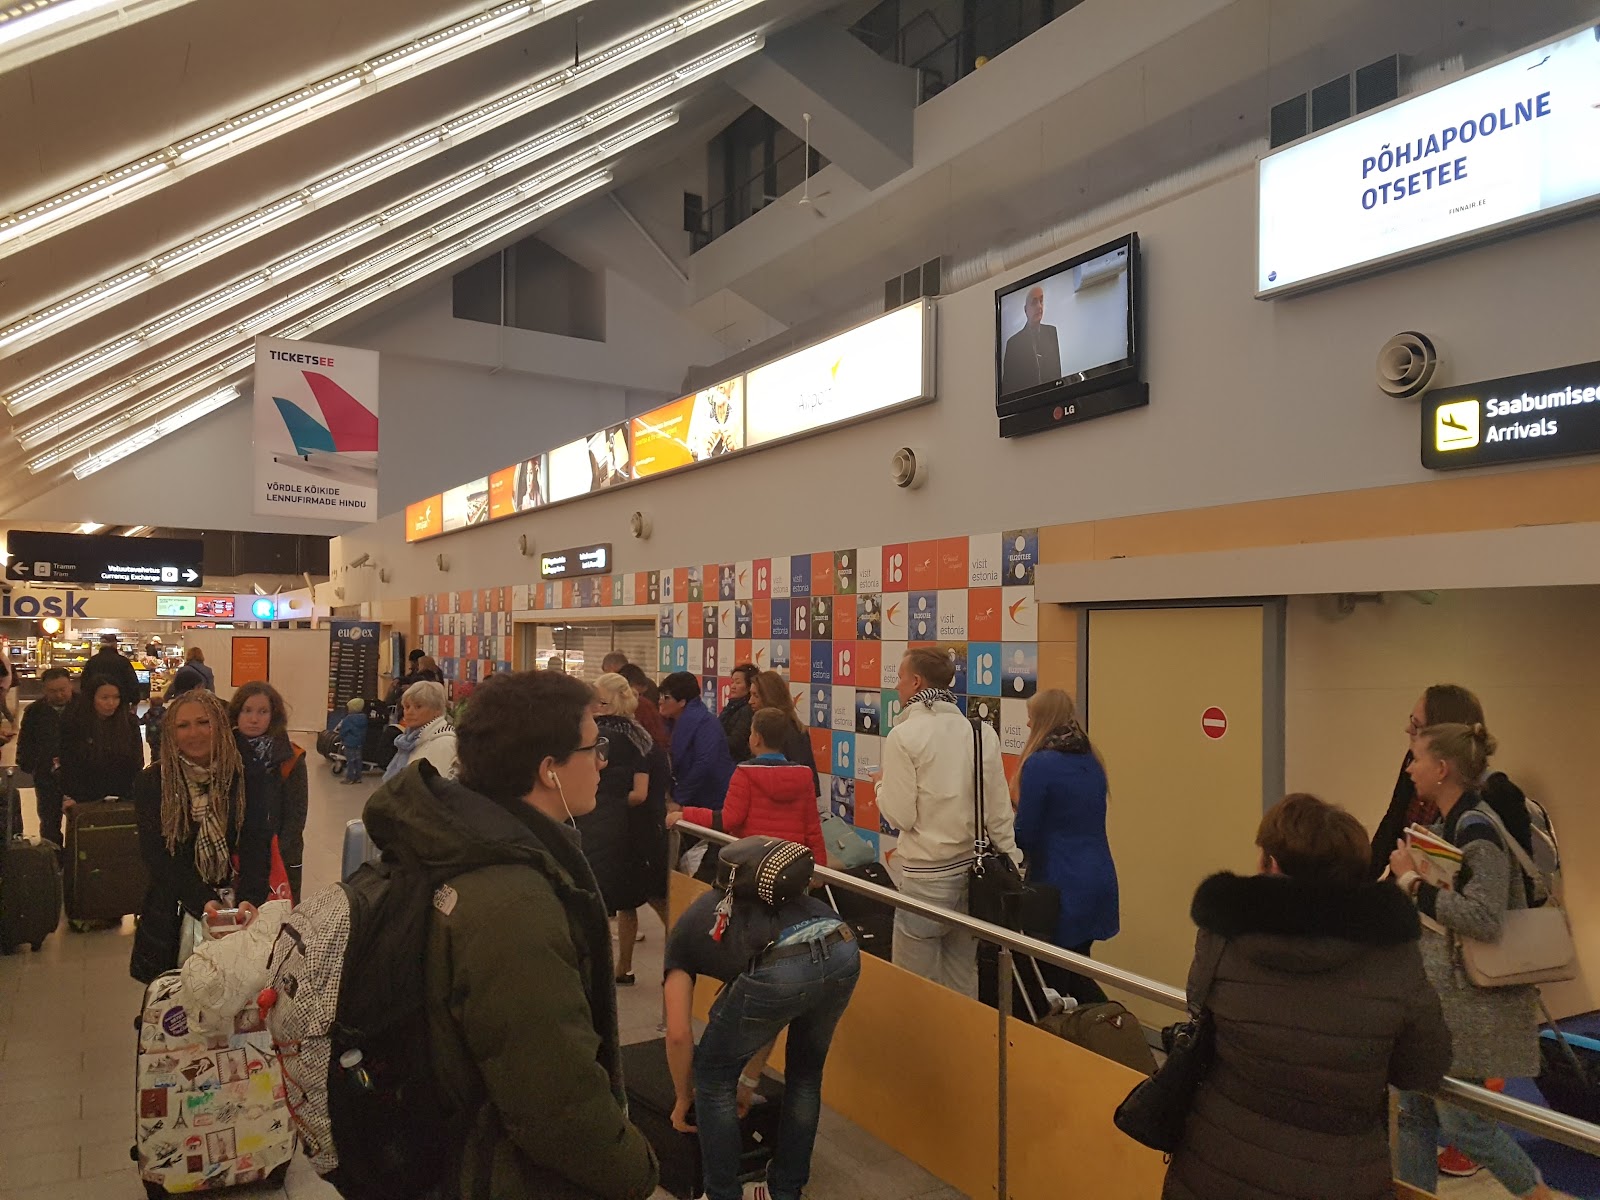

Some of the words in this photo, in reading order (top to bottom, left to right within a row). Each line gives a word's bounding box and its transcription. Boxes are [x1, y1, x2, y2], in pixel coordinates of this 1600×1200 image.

[1362, 91, 1551, 179] PÕHJAPOOLNE
[1361, 156, 1468, 210] OTSETEE
[1449, 199, 1486, 214] FINNAIR.EE
[1064, 405, 1075, 416] LG
[1486, 418, 1557, 443] Arrivals
[267, 482, 302, 493] VÕRDLE
[304, 485, 340, 495] KÕIKIDE
[266, 494, 337, 506] LENNUFIRMADE
[339, 500, 367, 508] HINDU
[972, 558, 988, 569] visit
[972, 571, 998, 582] estonia
[860, 579, 880, 588] estonia
[940, 612, 955, 624] visit
[940, 625, 965, 635] estonia
[812, 660, 824, 669] visit
[884, 664, 897, 673] visit
[812, 671, 831, 679] estonia
[884, 674, 899, 684] eston
[834, 718, 853, 727] estonia
[1005, 725, 1021, 736] visit
[1005, 738, 1026, 749] eston
